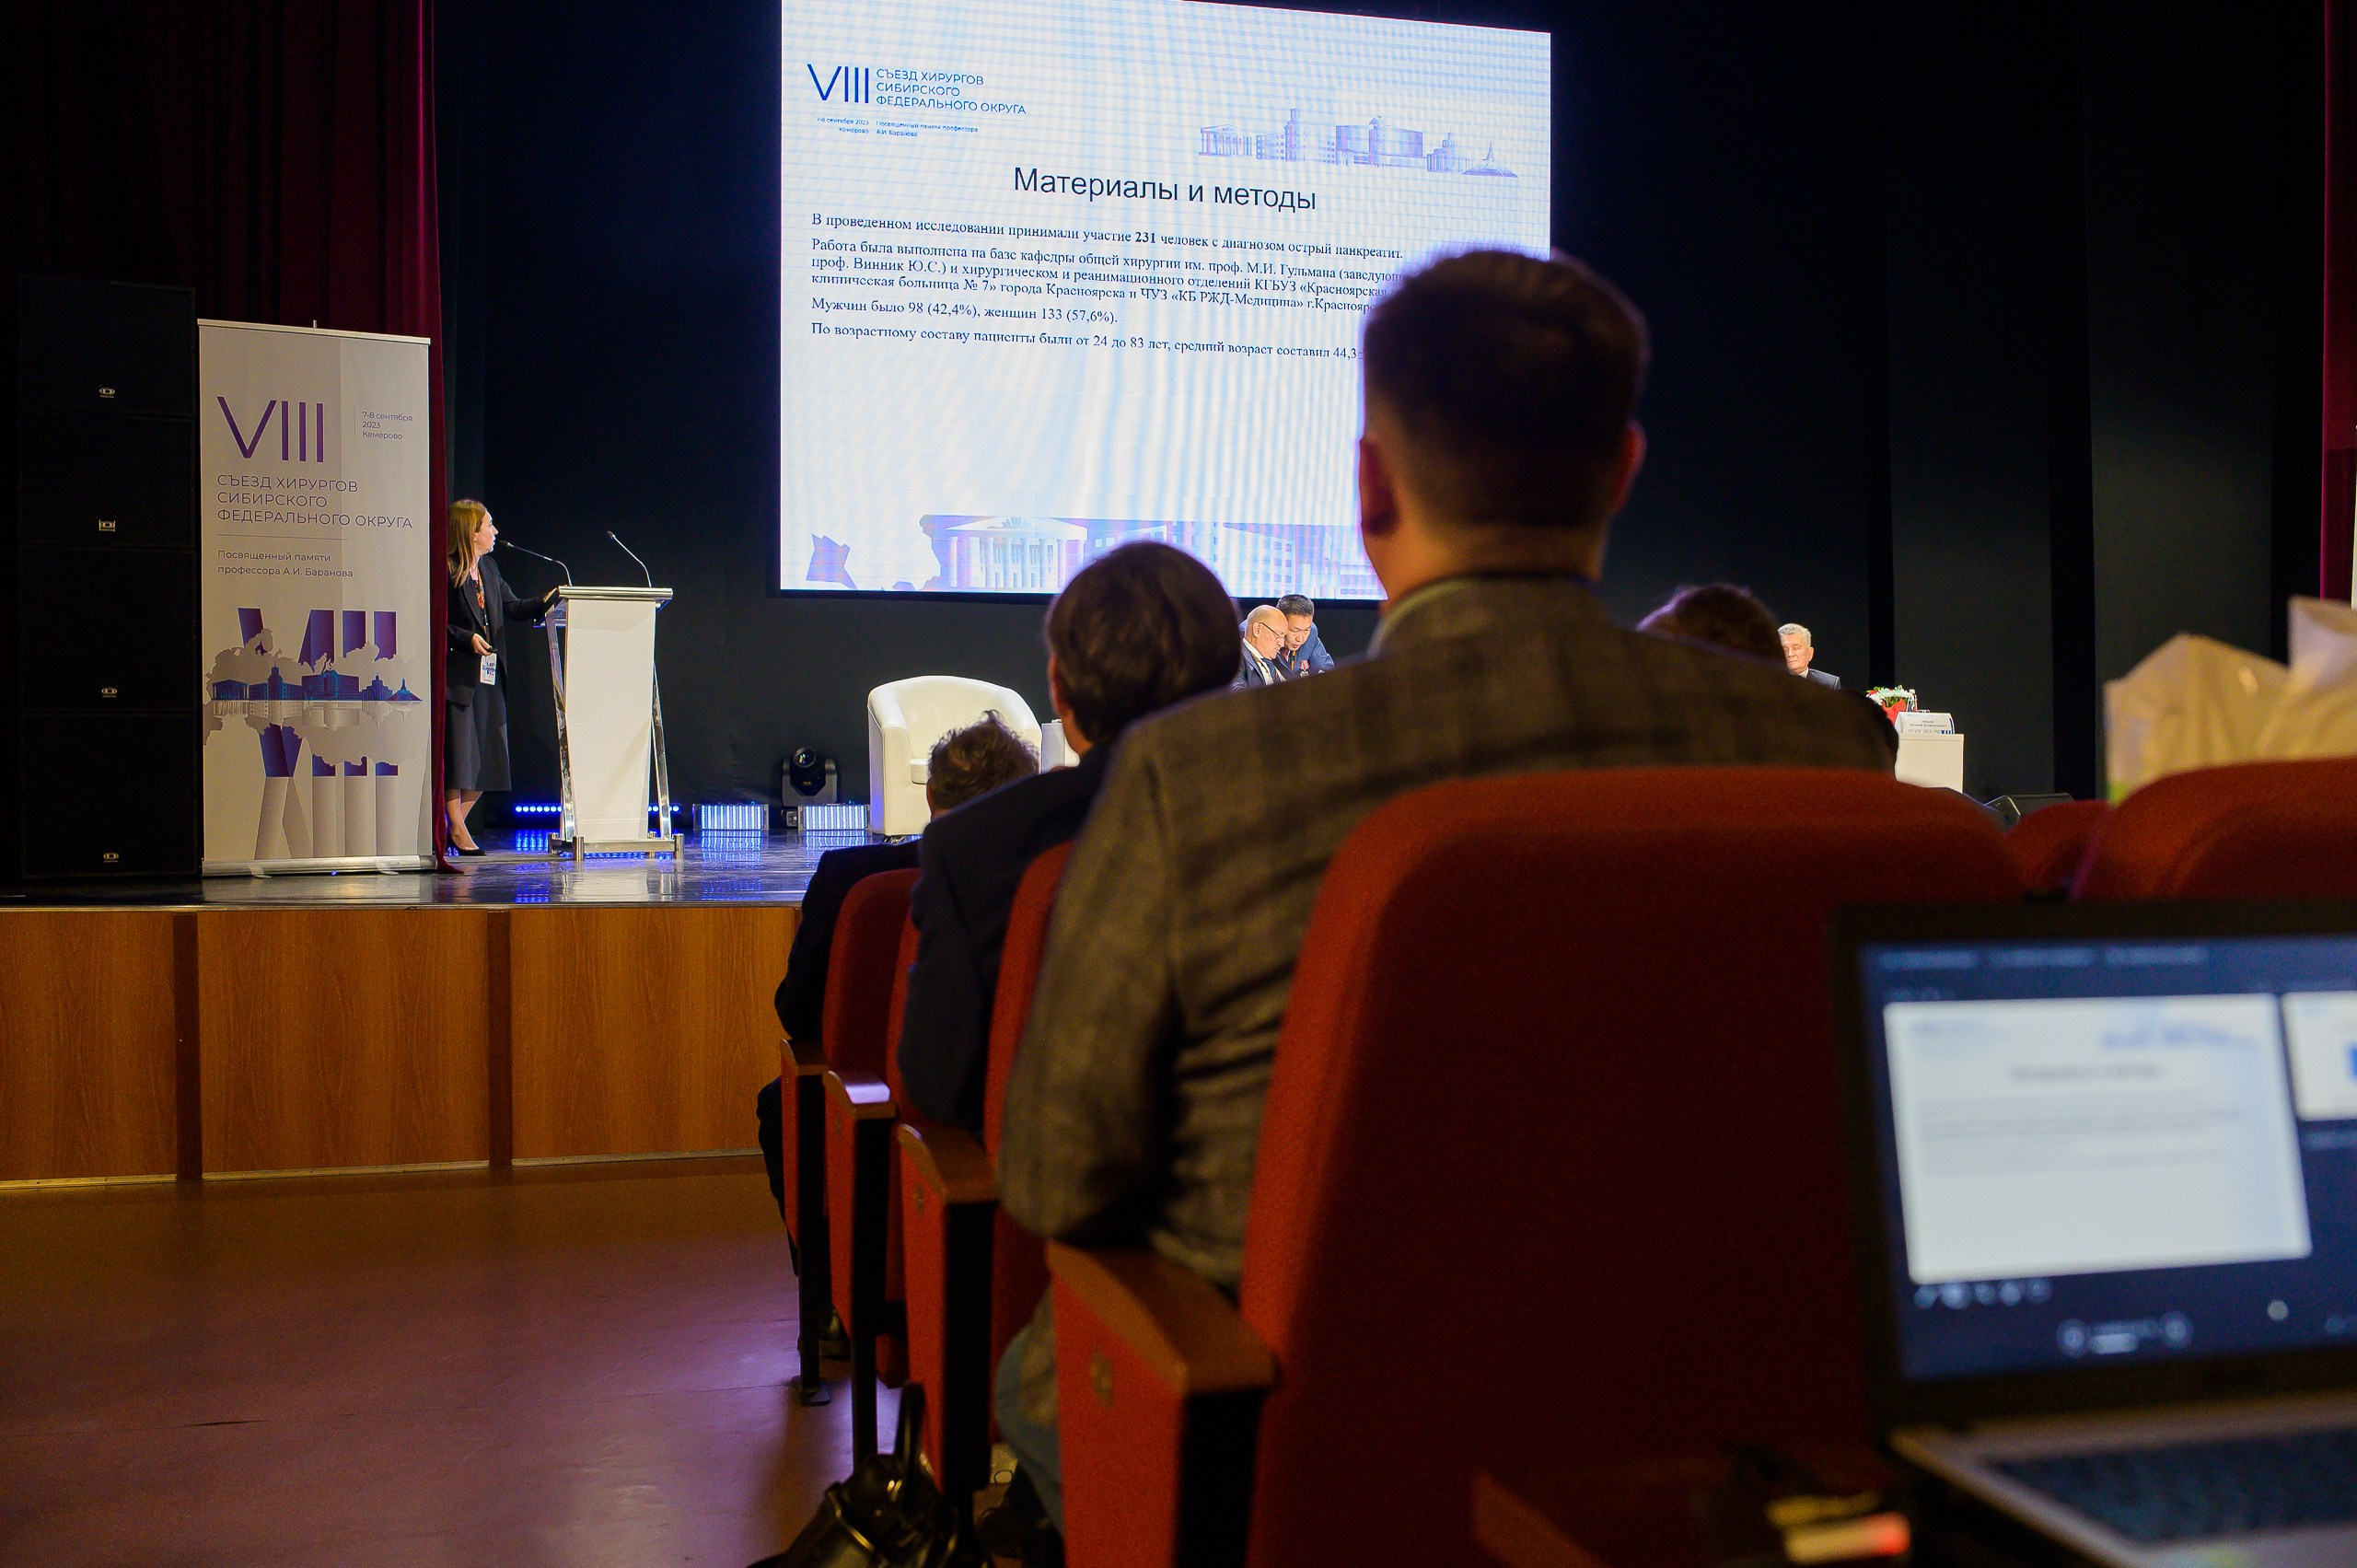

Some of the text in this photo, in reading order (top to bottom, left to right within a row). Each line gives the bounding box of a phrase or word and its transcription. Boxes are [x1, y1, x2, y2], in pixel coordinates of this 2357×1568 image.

[807, 64, 869, 104] VIII
[877, 68, 984, 86] СЪЕЗД ХИРУРГОВ
[877, 82, 960, 97] СИБИРСКОГО
[877, 95, 1027, 115] ФЕДЕРАЛЬНОГО ОКРУГА
[1014, 167, 1316, 213] Материалы и методы
[812, 214, 1403, 259] В проведенном исследовании принимали участие 231 человек с диагнозом острый панкреатит.
[812, 238, 856, 253] Работа
[861, 240, 893, 254] была
[898, 245, 967, 259] выполнена
[971, 249, 986, 259] на
[991, 248, 1016, 261] базе
[1021, 248, 1074, 265] кафедры
[1079, 252, 1119, 267] общей
[1123, 257, 1180, 272] хирургии
[1185, 261, 1205, 271] им.
[1209, 261, 1243, 275] проф.
[1247, 261, 1276, 274] М.И.
[1281, 264, 1336, 279] Гульмана
[812, 257, 1387, 298] проф. Винник Ю.С.) и хирургическом и реанимационного отделений КГБУЗ «Красноярская
[812, 274, 894, 288] клиническая
[899, 277, 959, 291] больница
[963, 279, 978, 291] №
[982, 280, 996, 292] 7»
[1001, 284, 1042, 296] города
[1046, 284, 1125, 299] Красноярска
[1130, 290, 1137, 299] и
[1141, 288, 1167, 301] ЧУЗ
[1171, 290, 1196, 302] «КБ
[1200, 292, 1303, 308] РЖД-Медицина»
[812, 297, 1117, 324] Мужчин было 98 (42,4%), женщин 133 (57,6%).
[812, 322, 830, 335] По
[834, 326, 916, 341] возрастному
[921, 331, 970, 344] составу
[974, 332, 1036, 346] пациенты
[1039, 332, 1072, 346] были
[1076, 336, 1090, 346] от
[1094, 335, 1108, 347] 24
[1111, 338, 1126, 349] до
[1130, 337, 1144, 348] 83
[1148, 340, 1171, 353] лет,
[1174, 341, 1225, 354] средний
[1227, 343, 1272, 357] возраст
[1276, 346, 1329, 358] составил
[362, 411, 412, 422] 7-8 сентября
[362, 421, 381, 429] 2023
[216, 396, 324, 462] VIII
[362, 430, 403, 440] Кемерово
[217, 474, 358, 493] СЪЕЗД ХИРУРГОВ
[217, 492, 327, 507] СИБИРСКОГО
[217, 508, 412, 528] ФЕДЕРАЛЬНОГО ОКРУГА
[217, 551, 292, 562] Посвященный
[217, 565, 354, 577] профессора А.И. Баранова
